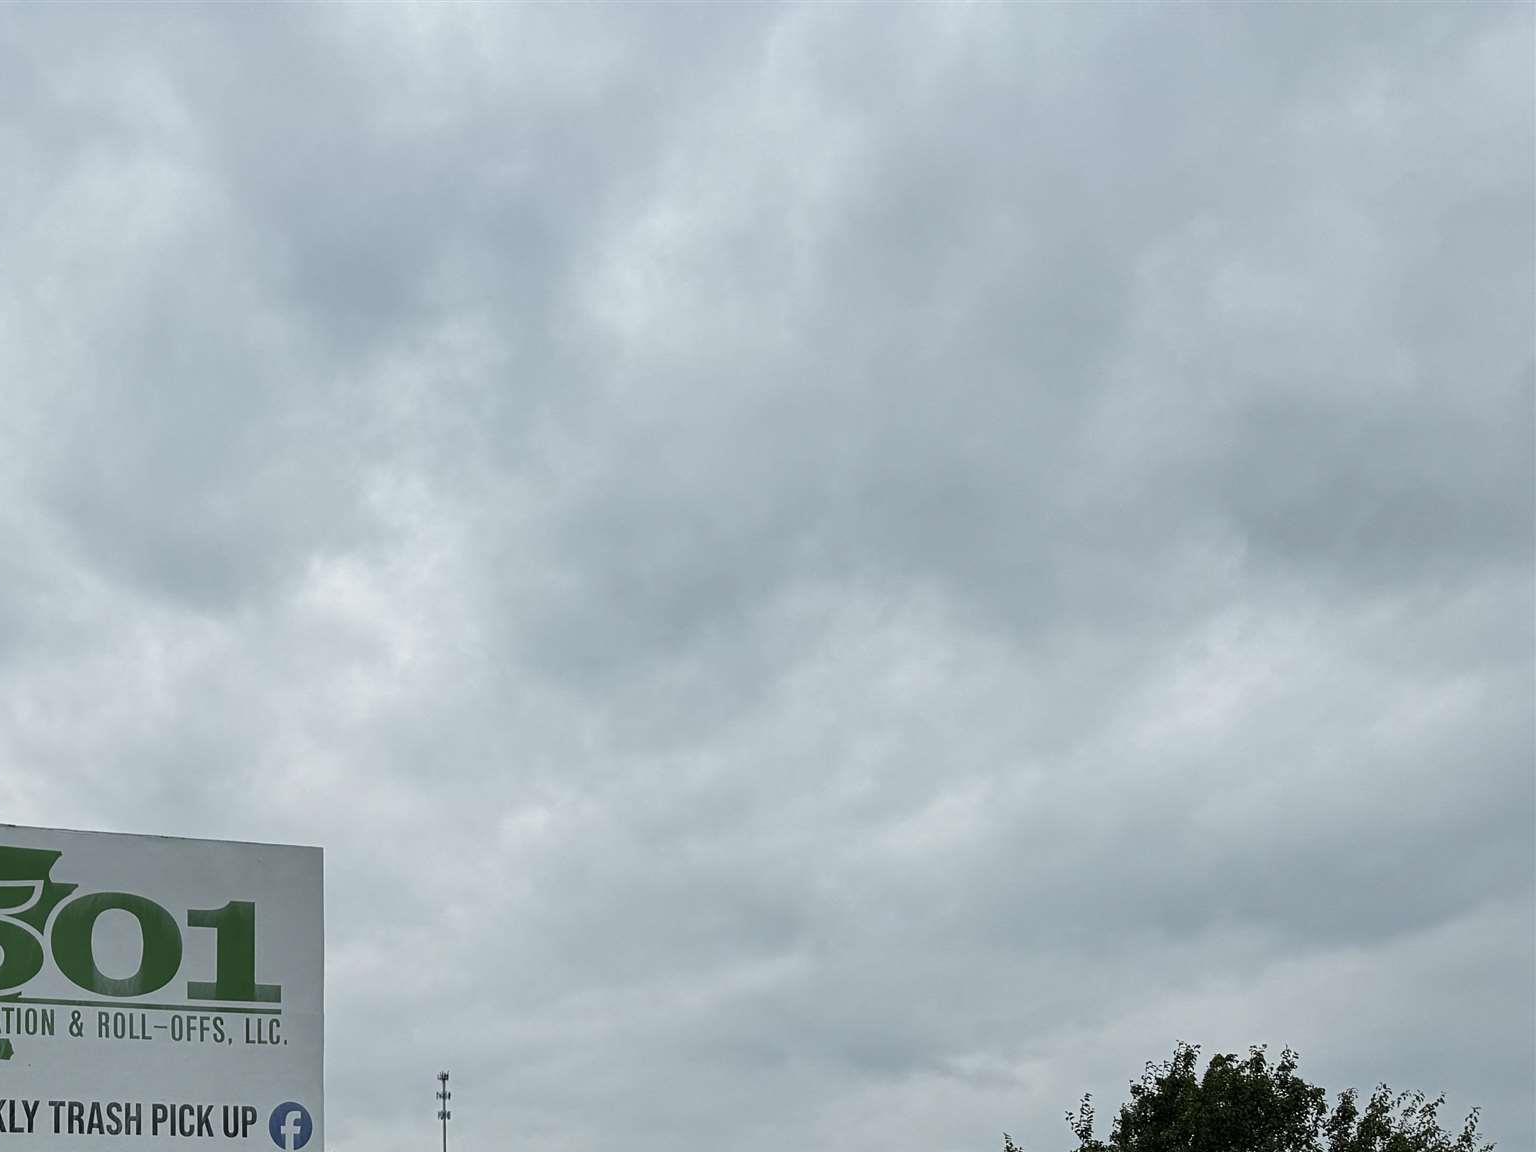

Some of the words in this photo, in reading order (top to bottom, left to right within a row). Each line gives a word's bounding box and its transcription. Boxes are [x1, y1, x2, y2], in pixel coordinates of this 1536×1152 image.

[68, 1010, 84, 1038] &
[97, 1011, 233, 1045] ROLL-OFFS,
[245, 1017, 288, 1045] LLC.
[48, 1101, 142, 1136] TRASH
[151, 1104, 215, 1137] PICK
[222, 1105, 258, 1138] UP
